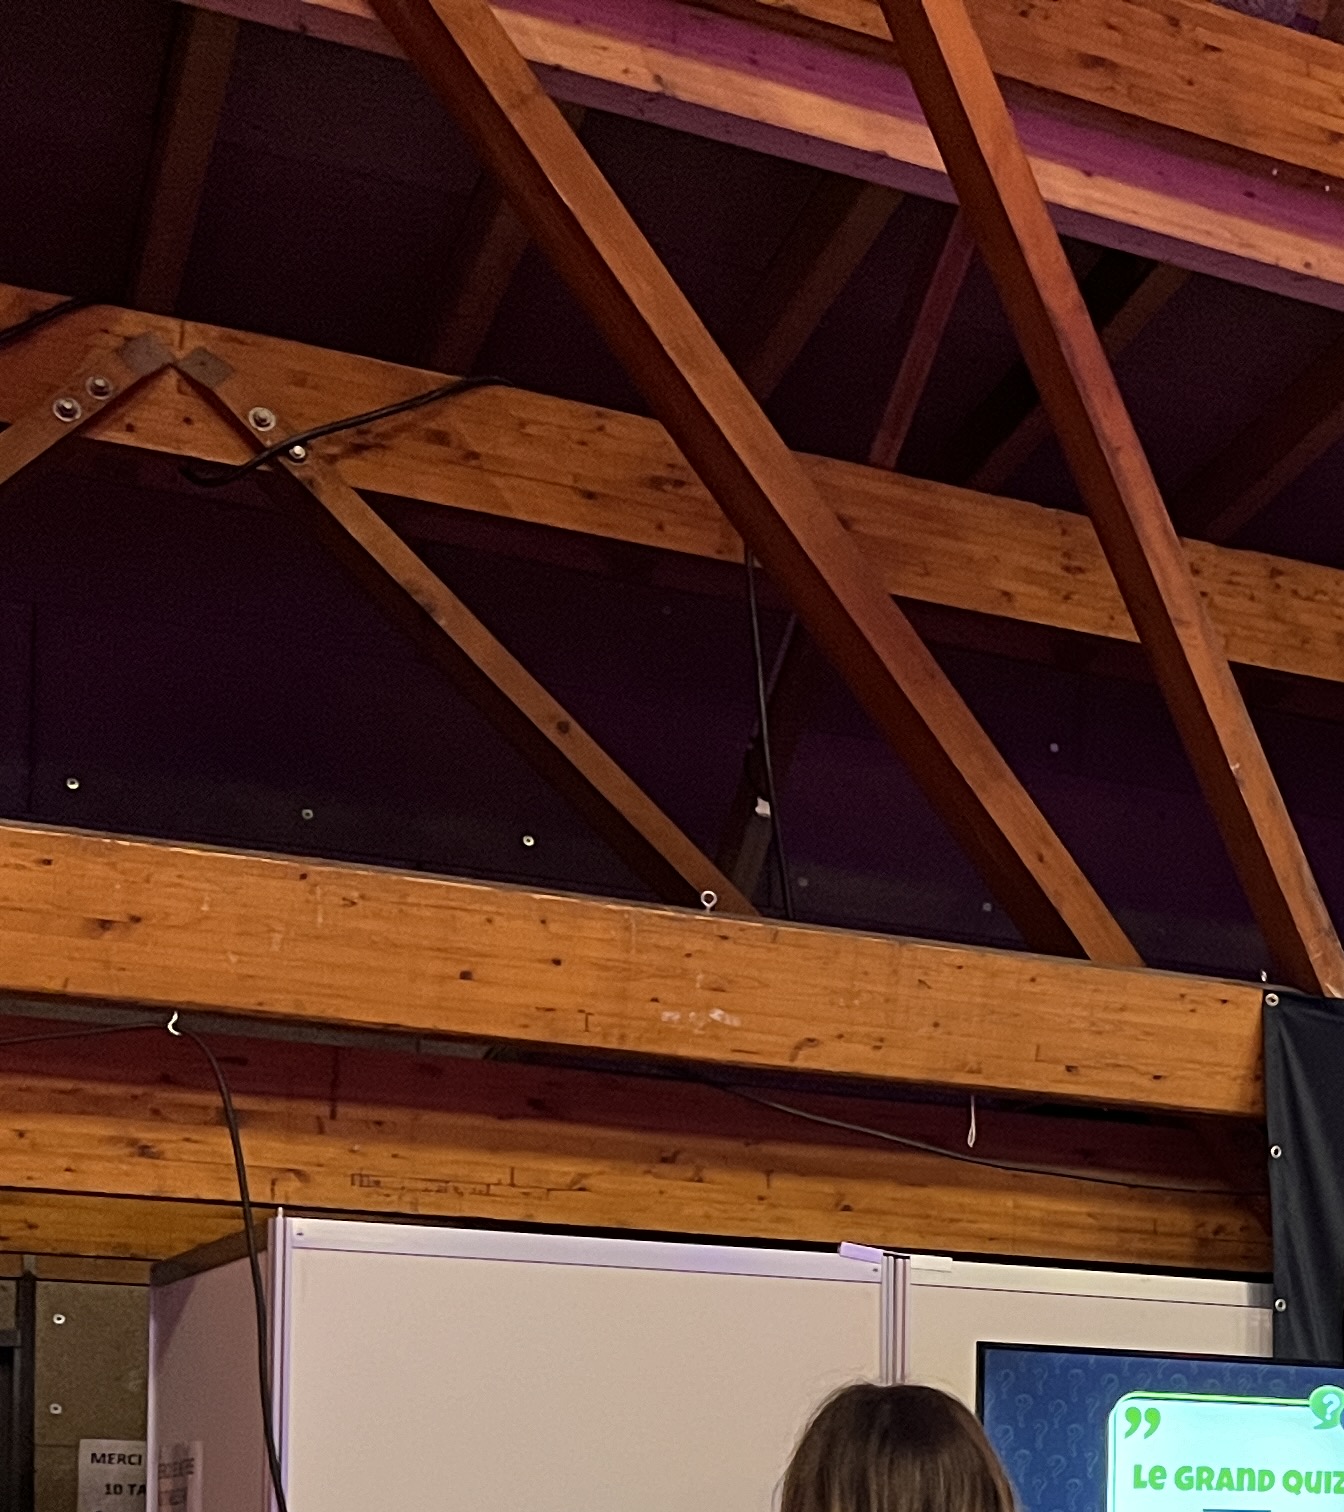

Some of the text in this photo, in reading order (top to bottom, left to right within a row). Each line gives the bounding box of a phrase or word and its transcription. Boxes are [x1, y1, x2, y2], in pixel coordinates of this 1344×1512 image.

[91, 1453, 142, 1466] MERCI
[1174, 1465, 1275, 1492] GRAND
[105, 1484, 123, 1495] 10
